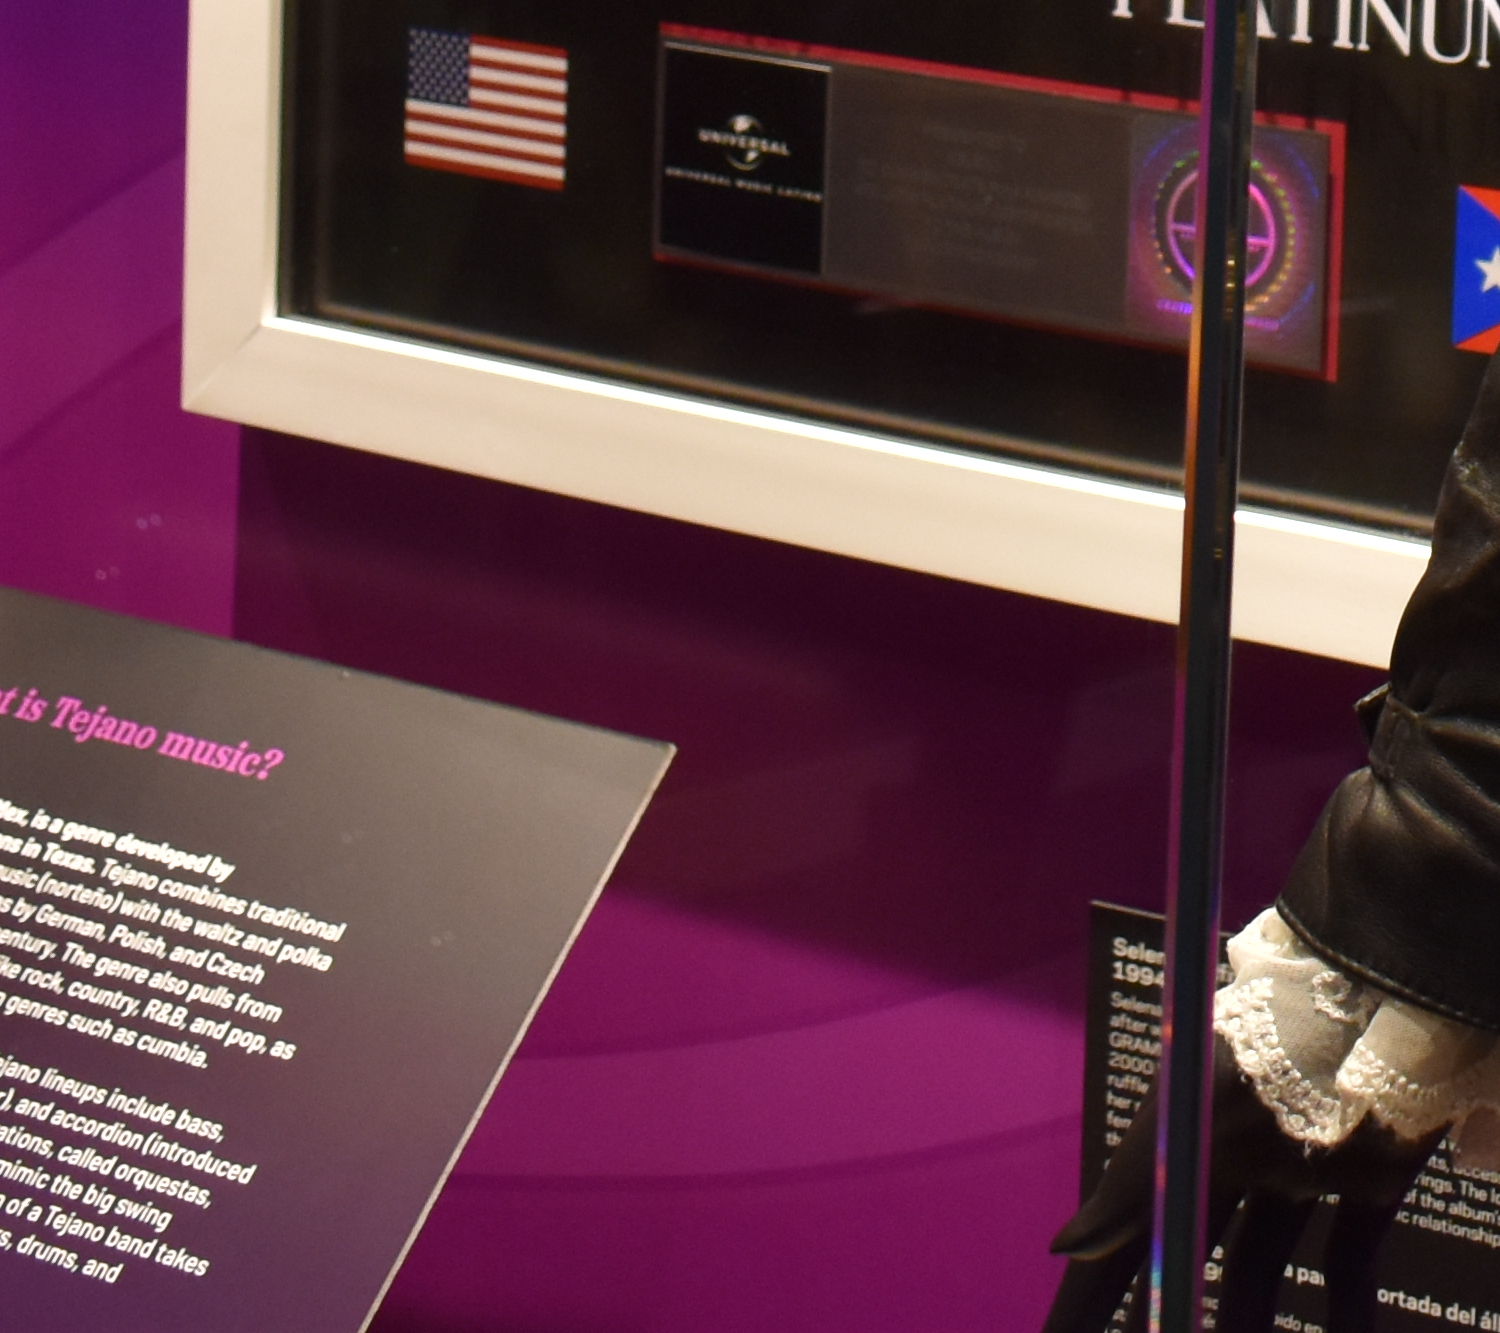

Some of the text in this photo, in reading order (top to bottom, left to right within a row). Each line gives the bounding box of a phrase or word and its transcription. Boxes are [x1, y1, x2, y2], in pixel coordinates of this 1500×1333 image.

[698, 128, 792, 158] UNIVERSAL
[15, 689, 46, 721] is
[52, 697, 157, 748] Tejano
[158, 732, 284, 780] music?
[30, 809, 50, 829] is
[48, 818, 64, 833] a
[61, 821, 116, 847] genre
[115, 833, 213, 873] developed
[207, 856, 235, 883] by
[21, 837, 42, 858] in
[42, 842, 95, 873] Texas.
[101, 858, 158, 890] Tejano
[158, 878, 247, 914] combines
[247, 900, 347, 941] traditional
[11, 897, 37, 922] by
[35, 903, 105, 940] German,
[108, 924, 166, 958] Polish,
[169, 945, 210, 968] and
[206, 951, 264, 984] Czech
[36, 871, 123, 912] (norteño)
[119, 899, 161, 922] with
[160, 908, 193, 931] the
[193, 919, 244, 946] waltz
[241, 934, 283, 956] and
[276, 944, 332, 971] polka
[1109, 1050, 1155, 1076] 2000
[1419, 1192, 1446, 1213] the
[1458, 1180, 1488, 1202] The
[1445, 1302, 1477, 1326] del
